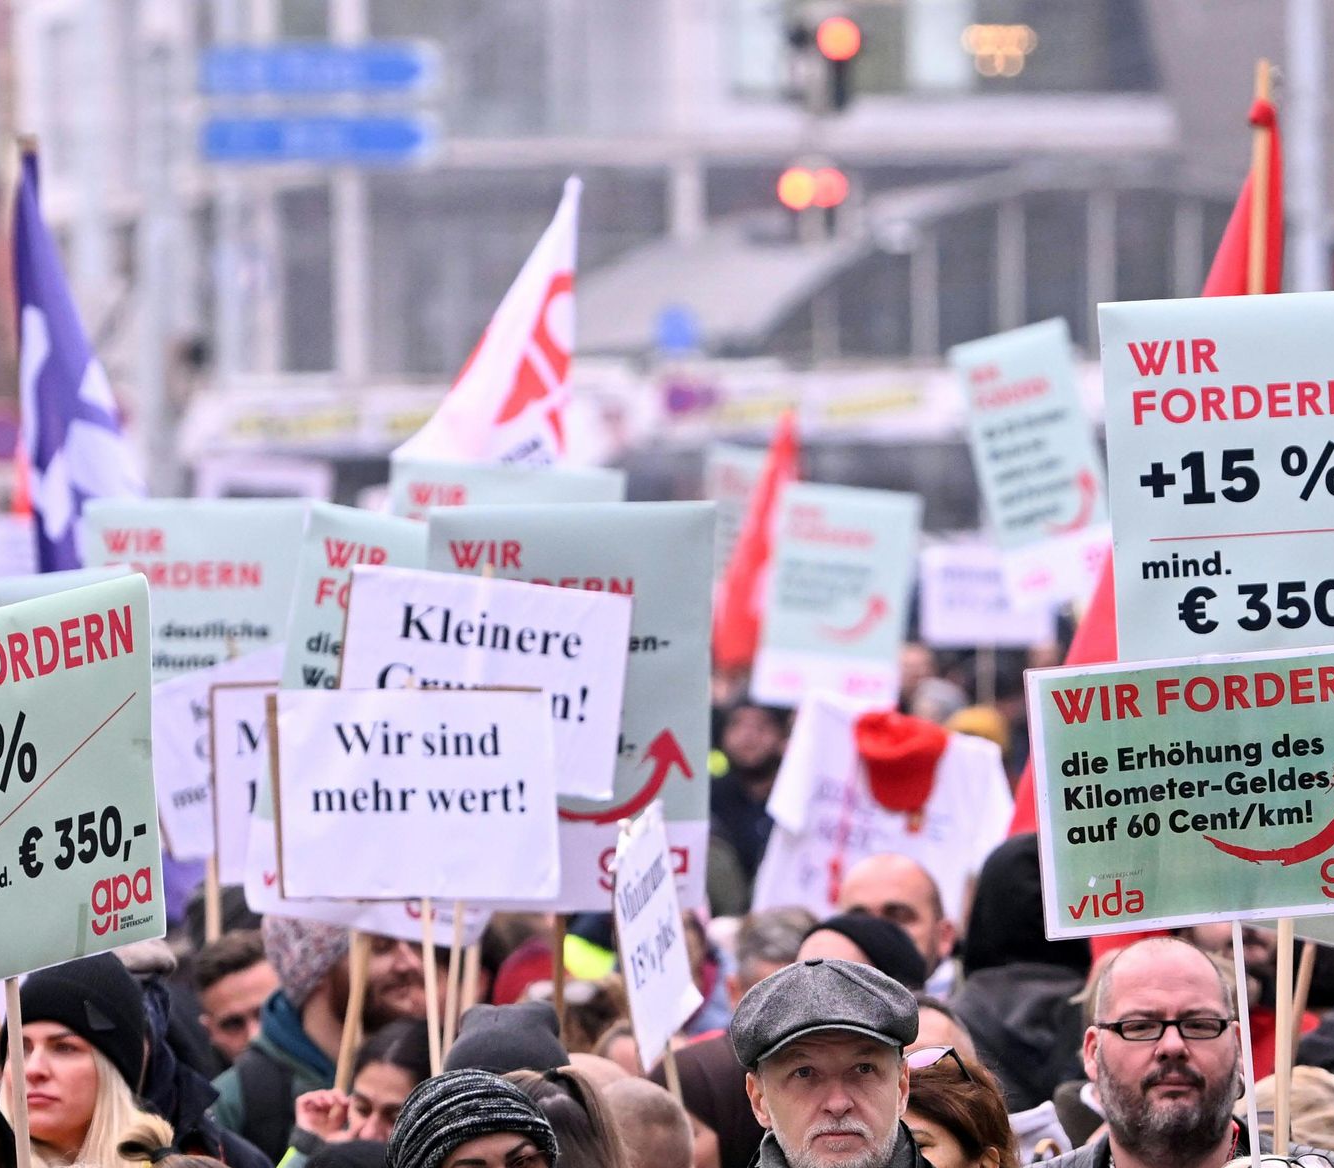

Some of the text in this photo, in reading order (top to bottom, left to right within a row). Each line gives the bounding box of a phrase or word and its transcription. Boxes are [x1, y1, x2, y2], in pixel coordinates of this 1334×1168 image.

[1128, 338, 1219, 376] WIR
[1139, 448, 1260, 505] +15
[102, 529, 164, 553] WIR
[324, 537, 388, 568] WIR
[449, 540, 522, 568] WIR
[104, 561, 262, 588] RDERN
[1142, 551, 1232, 579] mind.
[400, 602, 582, 659] Kleinere
[1178, 587, 1219, 634] €
[1051, 683, 1142, 725] WIR
[334, 721, 501, 757] Wir sind
[1061, 734, 1325, 777] die Erhöhung des
[312, 781, 527, 814] mehr wert!
[1064, 769, 1330, 811] Kilometer-Geldes
[19, 826, 43, 879] €
[54, 805, 147, 862] 350,-
[1068, 799, 1313, 845] auf 60 Cent/km!
[91, 867, 153, 936] gpa
[1068, 879, 1144, 919] vida
